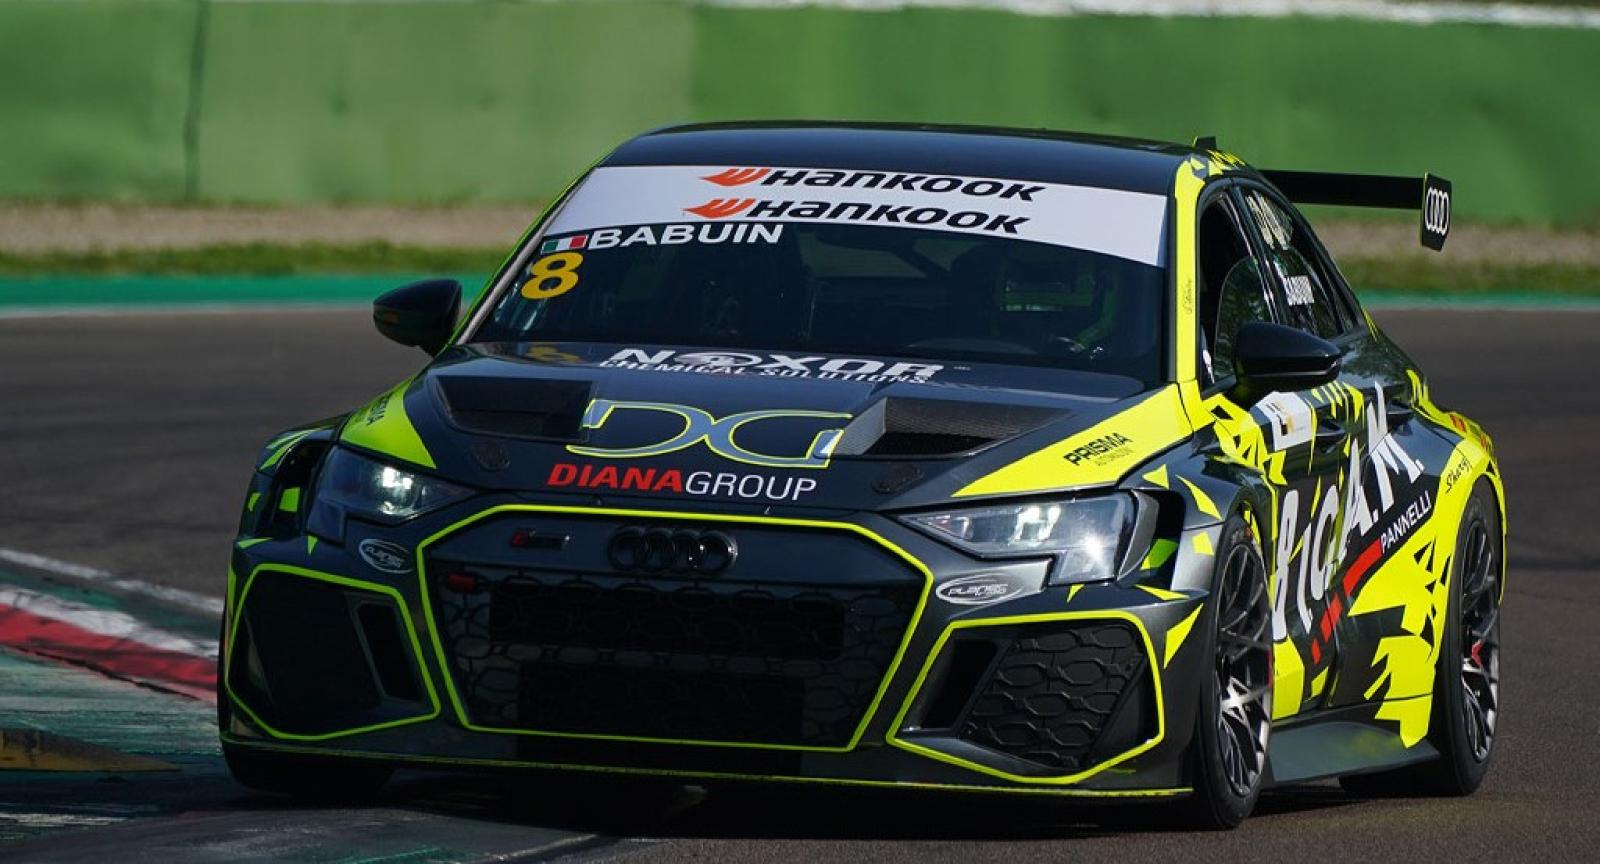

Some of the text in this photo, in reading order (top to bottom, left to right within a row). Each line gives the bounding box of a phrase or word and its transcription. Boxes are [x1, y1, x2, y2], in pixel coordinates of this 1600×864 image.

[587, 224, 784, 250] BABUIN
[521, 252, 584, 300] 8
[599, 360, 928, 384] CHEMICAL SOLUTIONS
[608, 348, 945, 377] NOXOR
[1063, 432, 1134, 466] PRISMA
[1381, 490, 1432, 554] PANNELLI
